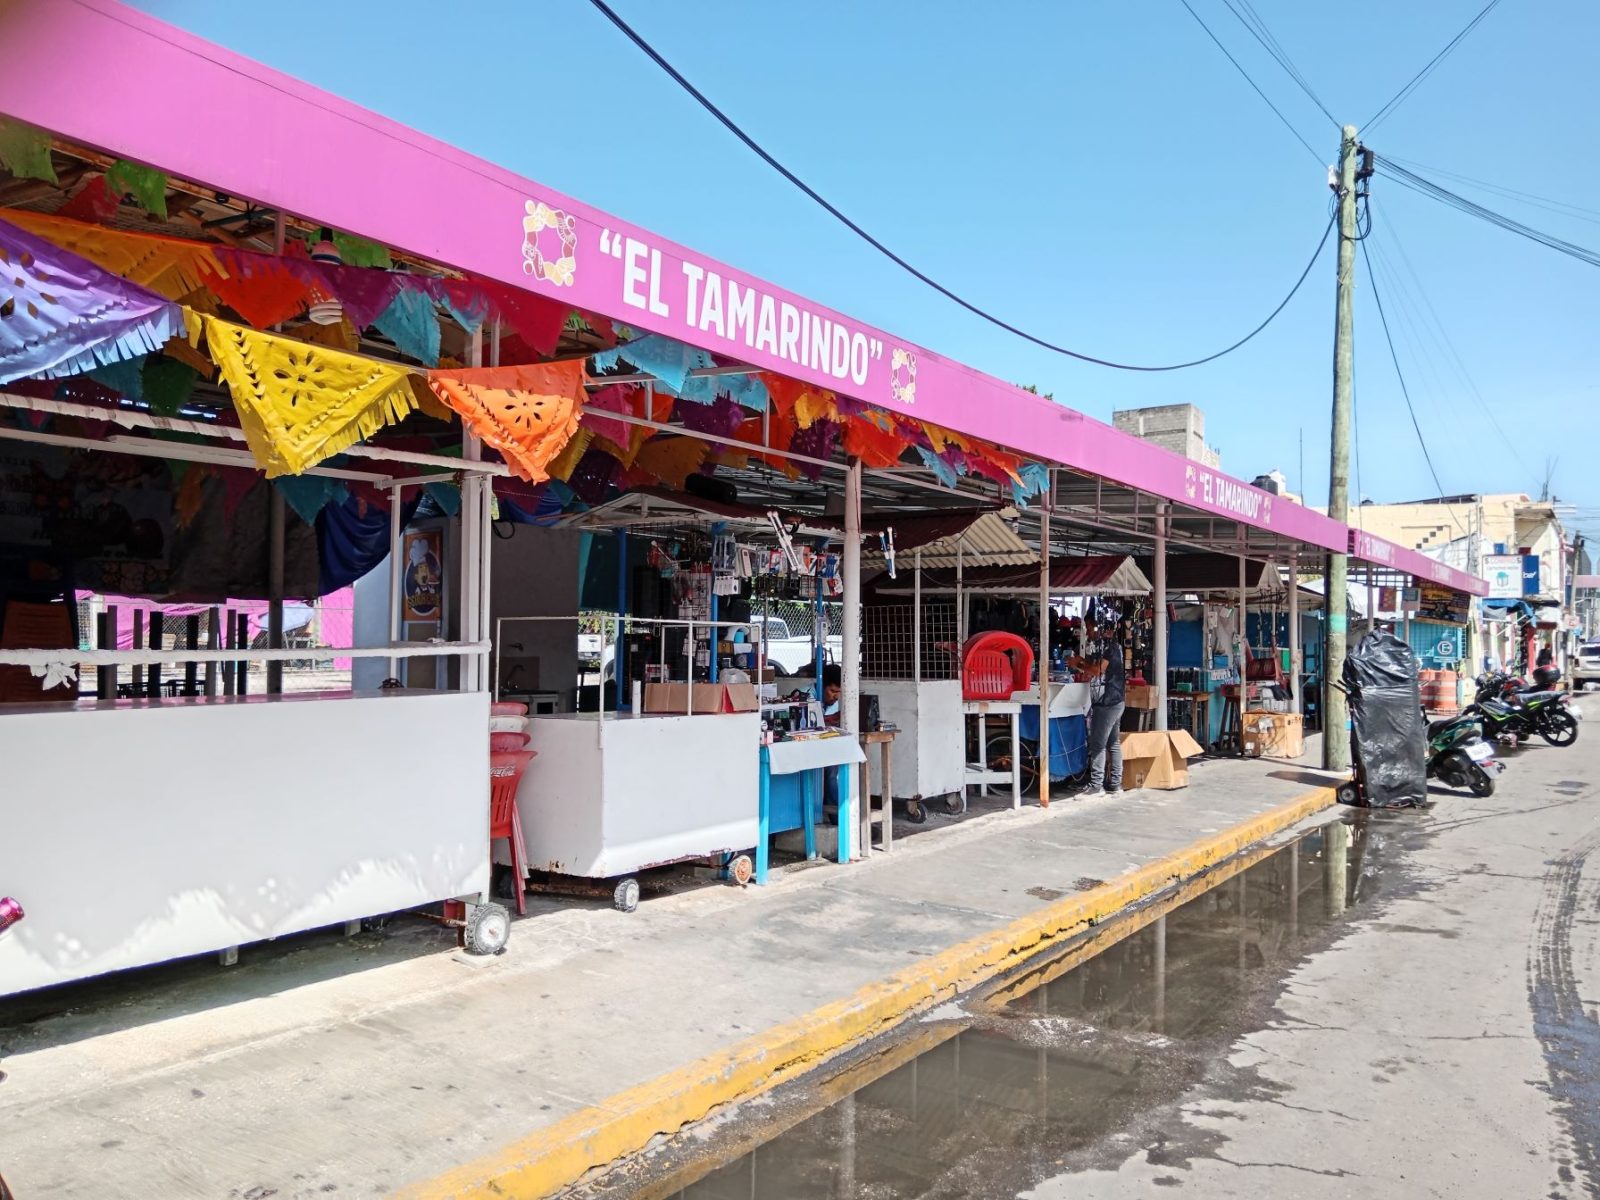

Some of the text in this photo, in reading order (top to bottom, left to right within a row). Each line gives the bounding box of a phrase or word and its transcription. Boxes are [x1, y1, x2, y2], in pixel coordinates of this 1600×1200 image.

[599, 227, 884, 387] “EL TAMARINDO”
[1215, 477, 1263, 520] TAMARINDO”
[1441, 643, 1450, 653] E
